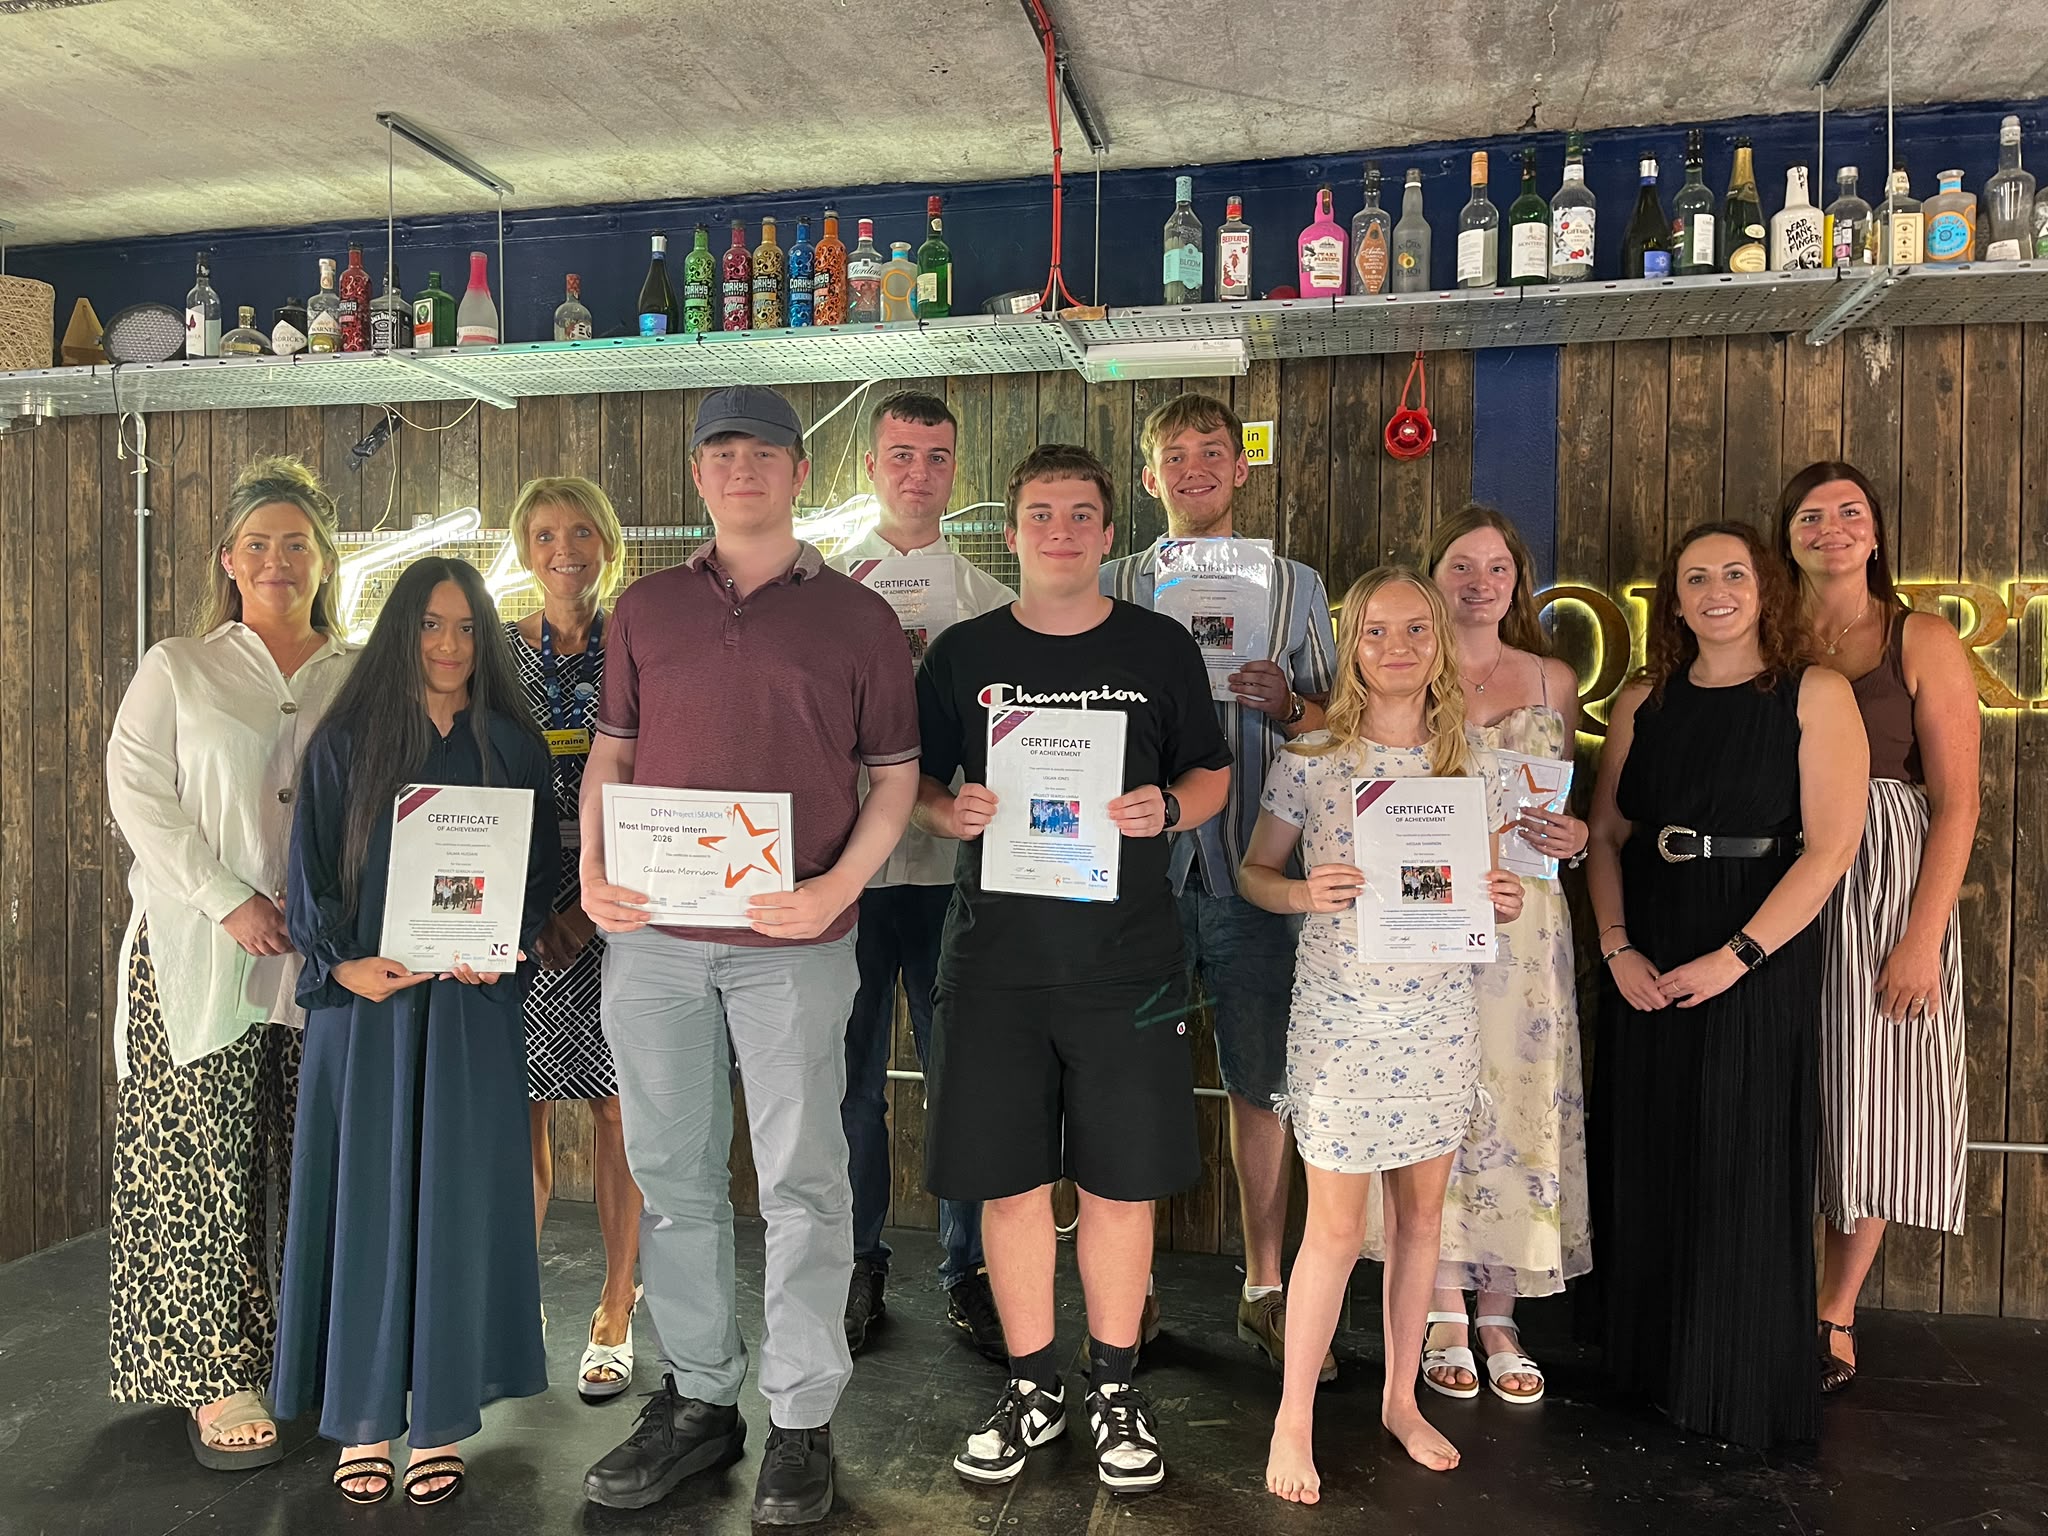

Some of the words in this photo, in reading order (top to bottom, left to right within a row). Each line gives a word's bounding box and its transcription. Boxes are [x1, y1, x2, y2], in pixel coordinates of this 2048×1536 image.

[1786, 218, 1808, 238] DEAD
[1222, 235, 1248, 244] BEEFEATER
[1179, 257, 1201, 267] BLOOM
[1247, 430, 1259, 441] in
[873, 579, 930, 589] CERTIFICATE
[977, 683, 1148, 710] Champion
[1021, 737, 1091, 749] CERTIFICATE
[650, 808, 672, 817] DFN
[672, 810, 694, 820] Project
[697, 811, 723, 819] SEARCH
[1385, 805, 1455, 815] CERTIFICATE
[427, 813, 499, 825] CERTIFICATE
[619, 822, 639, 831] Most
[641, 823, 680, 835] Improved
[682, 825, 707, 834] Intern
[652, 835, 673, 843] 2026
[643, 865, 676, 874] Callum
[677, 867, 719, 876] Morrison
[1466, 933, 1486, 946] NC
[490, 943, 509, 956] NC
